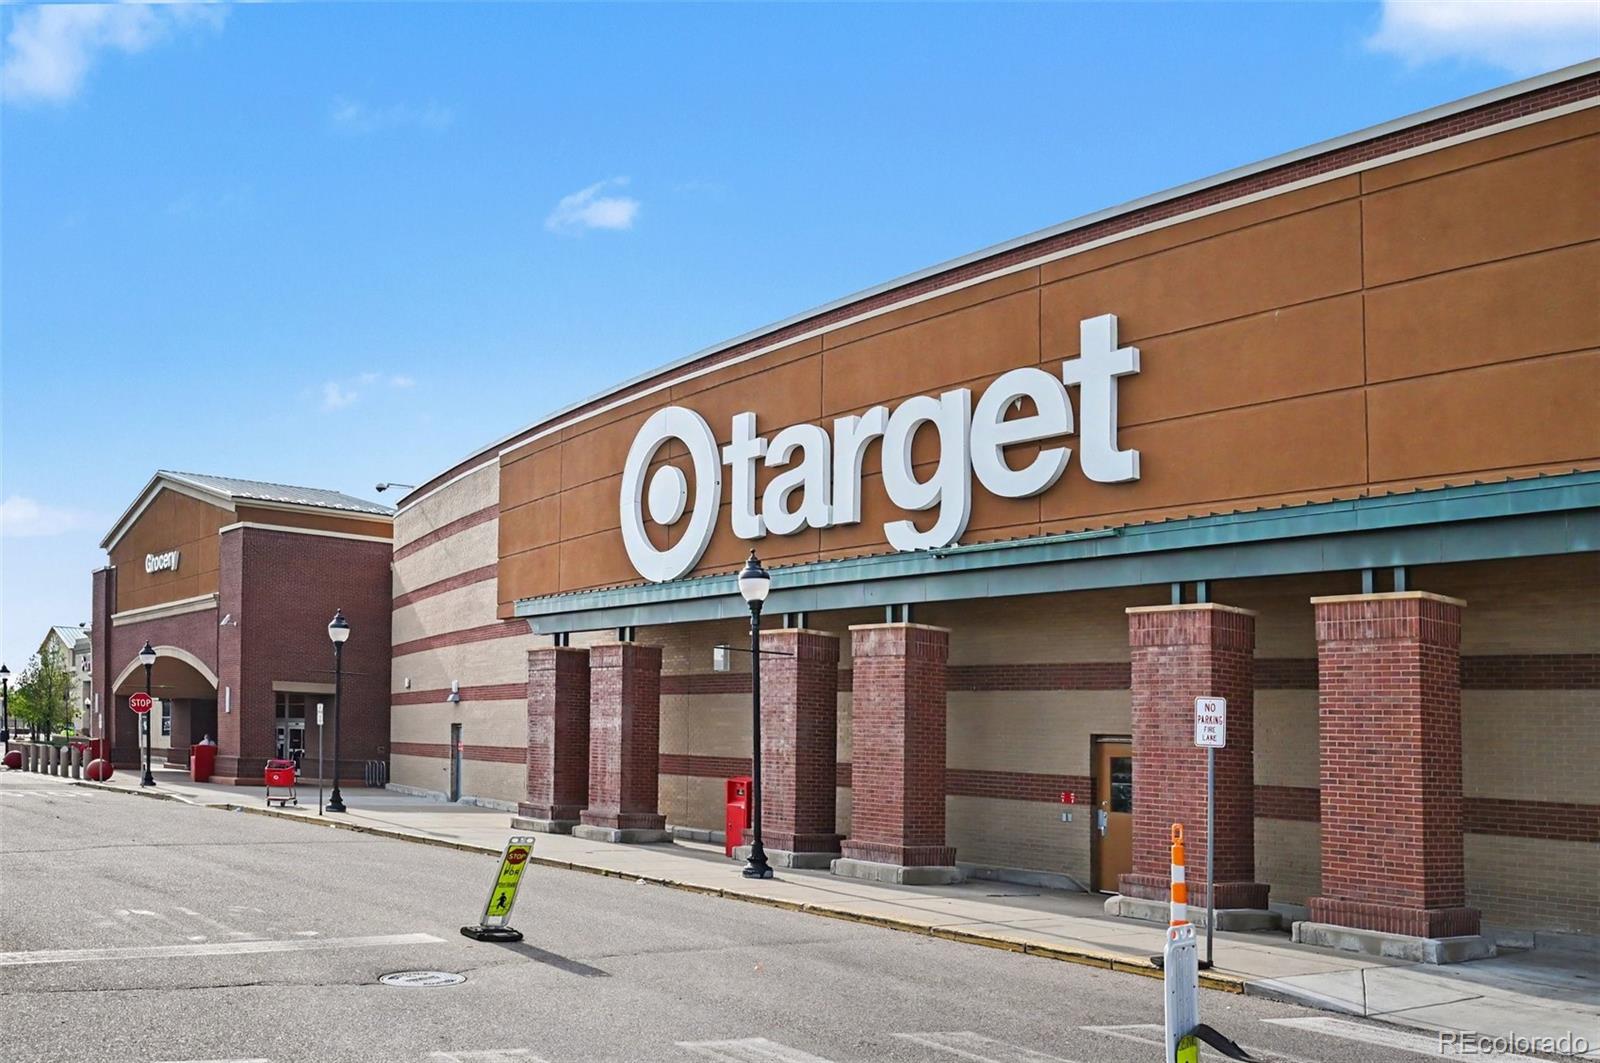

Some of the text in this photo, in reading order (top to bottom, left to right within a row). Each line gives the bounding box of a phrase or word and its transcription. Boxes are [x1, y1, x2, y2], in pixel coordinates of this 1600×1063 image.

[722, 313, 1140, 551] target
[145, 551, 180, 573] Grocery
[131, 698, 151, 707] STOP
[1204, 703, 1216, 713] NO
[1198, 715, 1223, 725] PARKING
[508, 852, 527, 860] STOP
